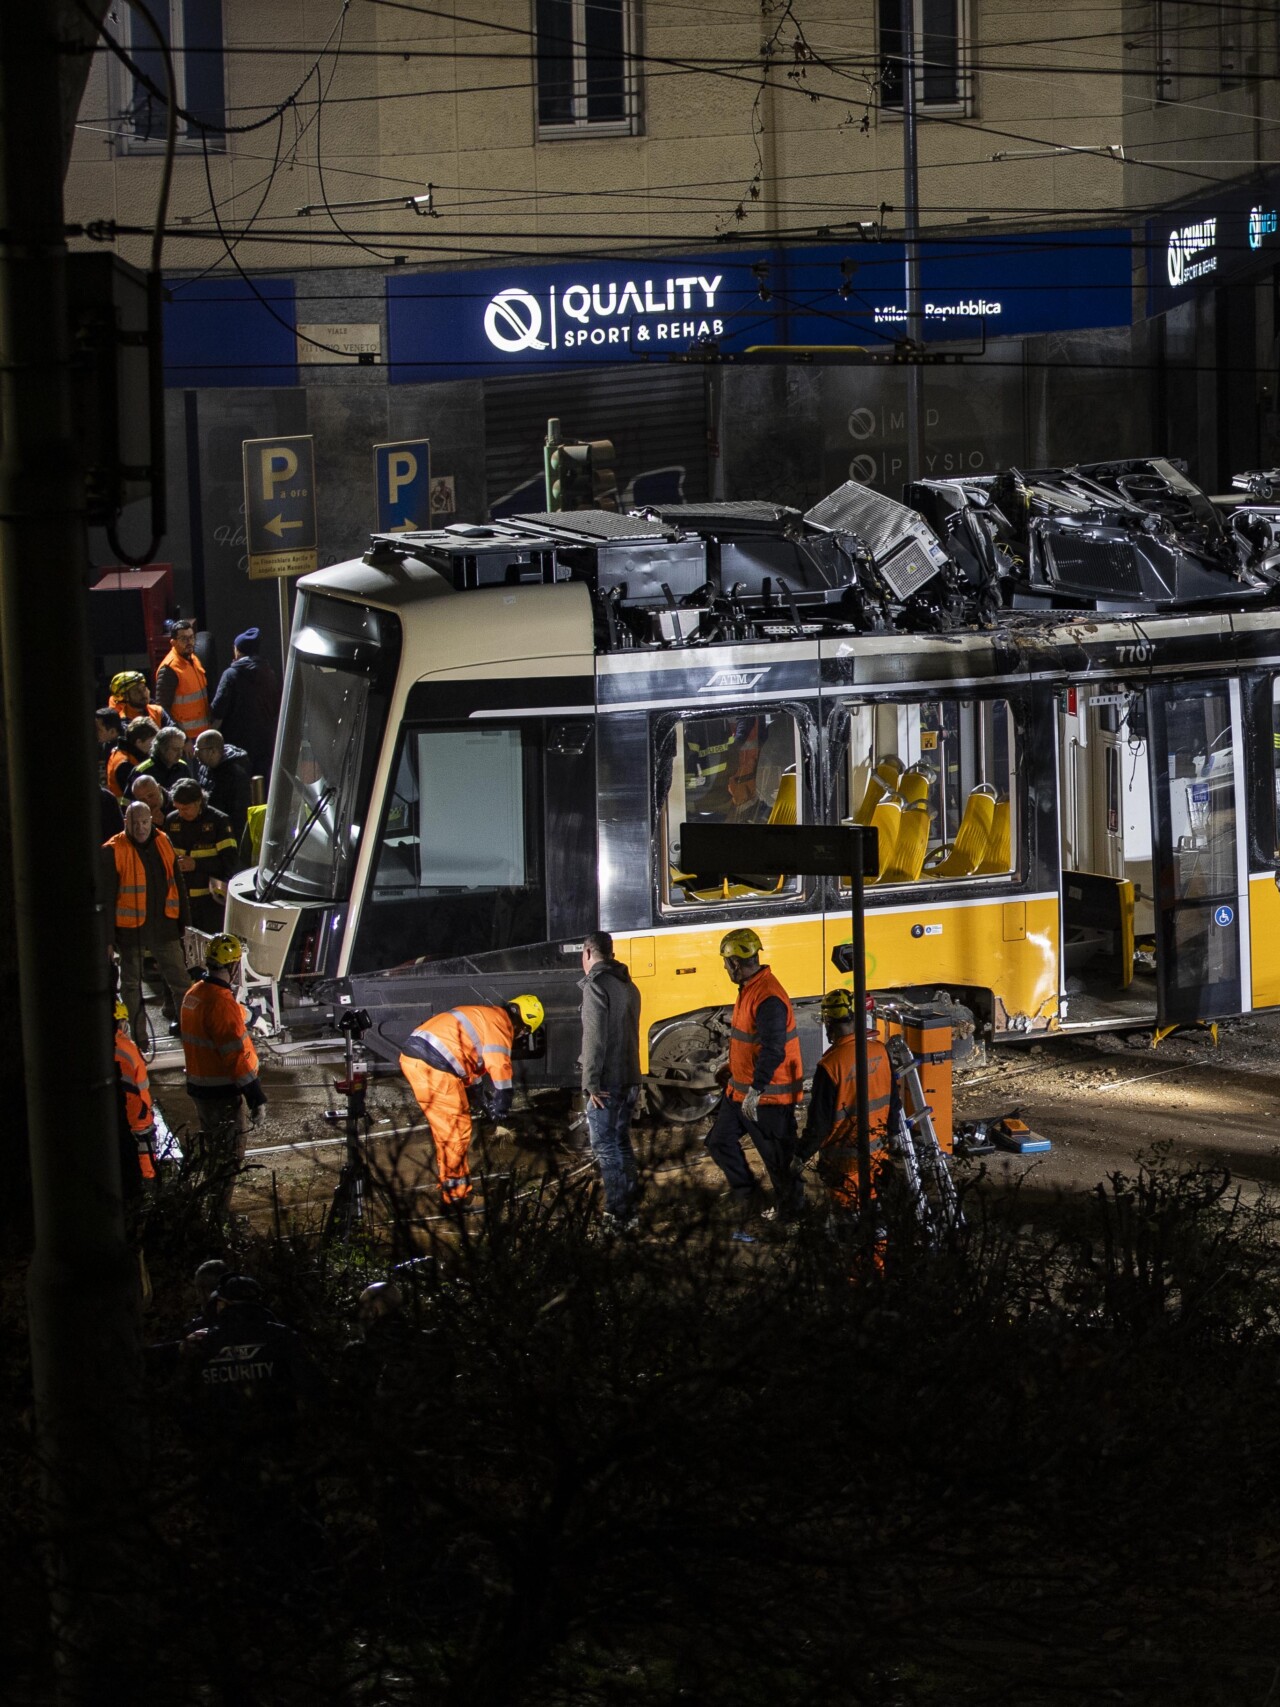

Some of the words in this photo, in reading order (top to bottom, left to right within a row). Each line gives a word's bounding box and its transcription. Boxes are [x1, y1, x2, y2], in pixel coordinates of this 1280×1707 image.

[1183, 217, 1217, 261] QUALITY
[562, 275, 722, 323] QUALITY
[925, 299, 1001, 322] Repubblica
[564, 326, 630, 347] SPORT
[637, 325, 650, 341] &
[657, 319, 724, 340] REHAB
[344, 343, 377, 353] VENETO
[890, 409, 939, 430] MD
[261, 447, 298, 500] P
[891, 451, 985, 477] PYSIO
[388, 451, 418, 504] P
[290, 488, 308, 498] ore
[1115, 644, 1156, 663] 7707
[719, 673, 748, 686] ATM
[201, 1362, 274, 1384] SECURITY
